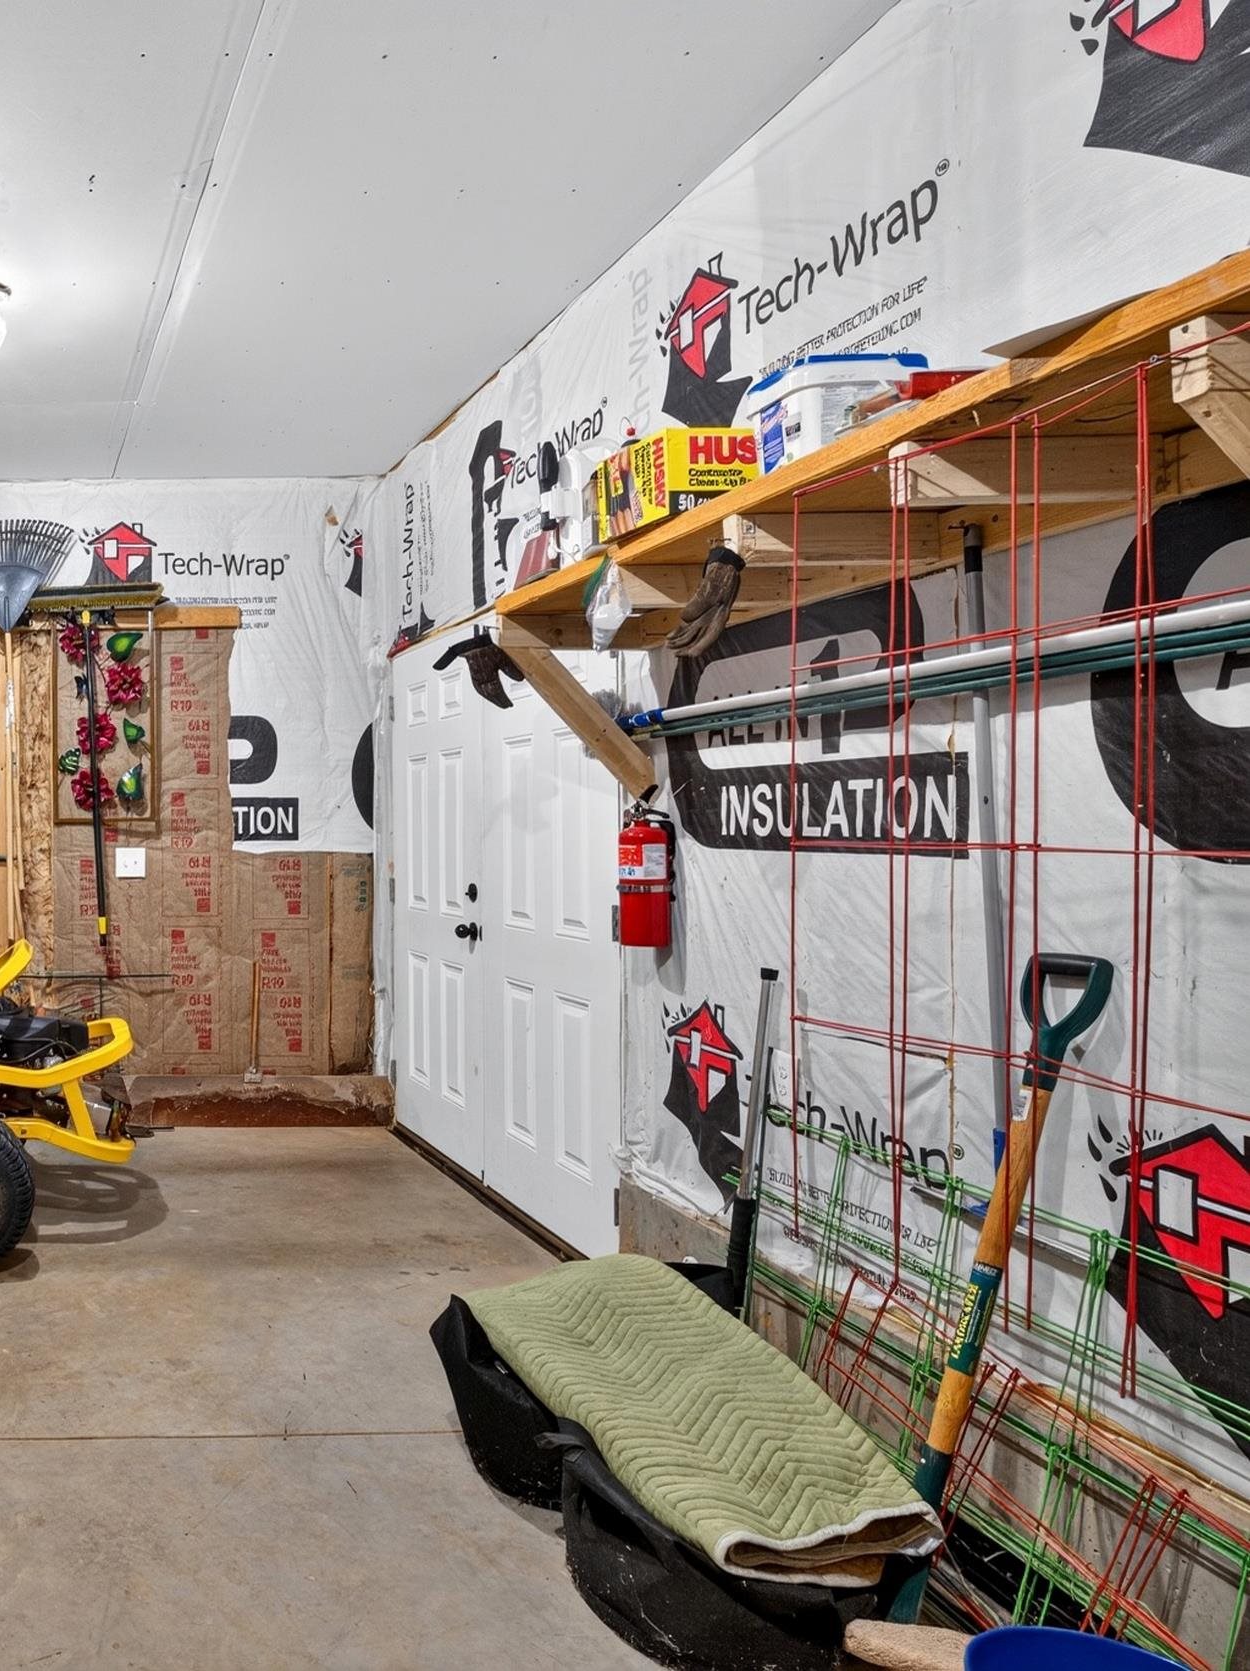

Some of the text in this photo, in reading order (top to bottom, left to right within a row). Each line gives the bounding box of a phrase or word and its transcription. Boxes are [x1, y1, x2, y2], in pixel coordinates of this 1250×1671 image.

[881, 292, 900, 312] FOR
[689, 435, 757, 465] HUS
[720, 774, 957, 838] INSULATION
